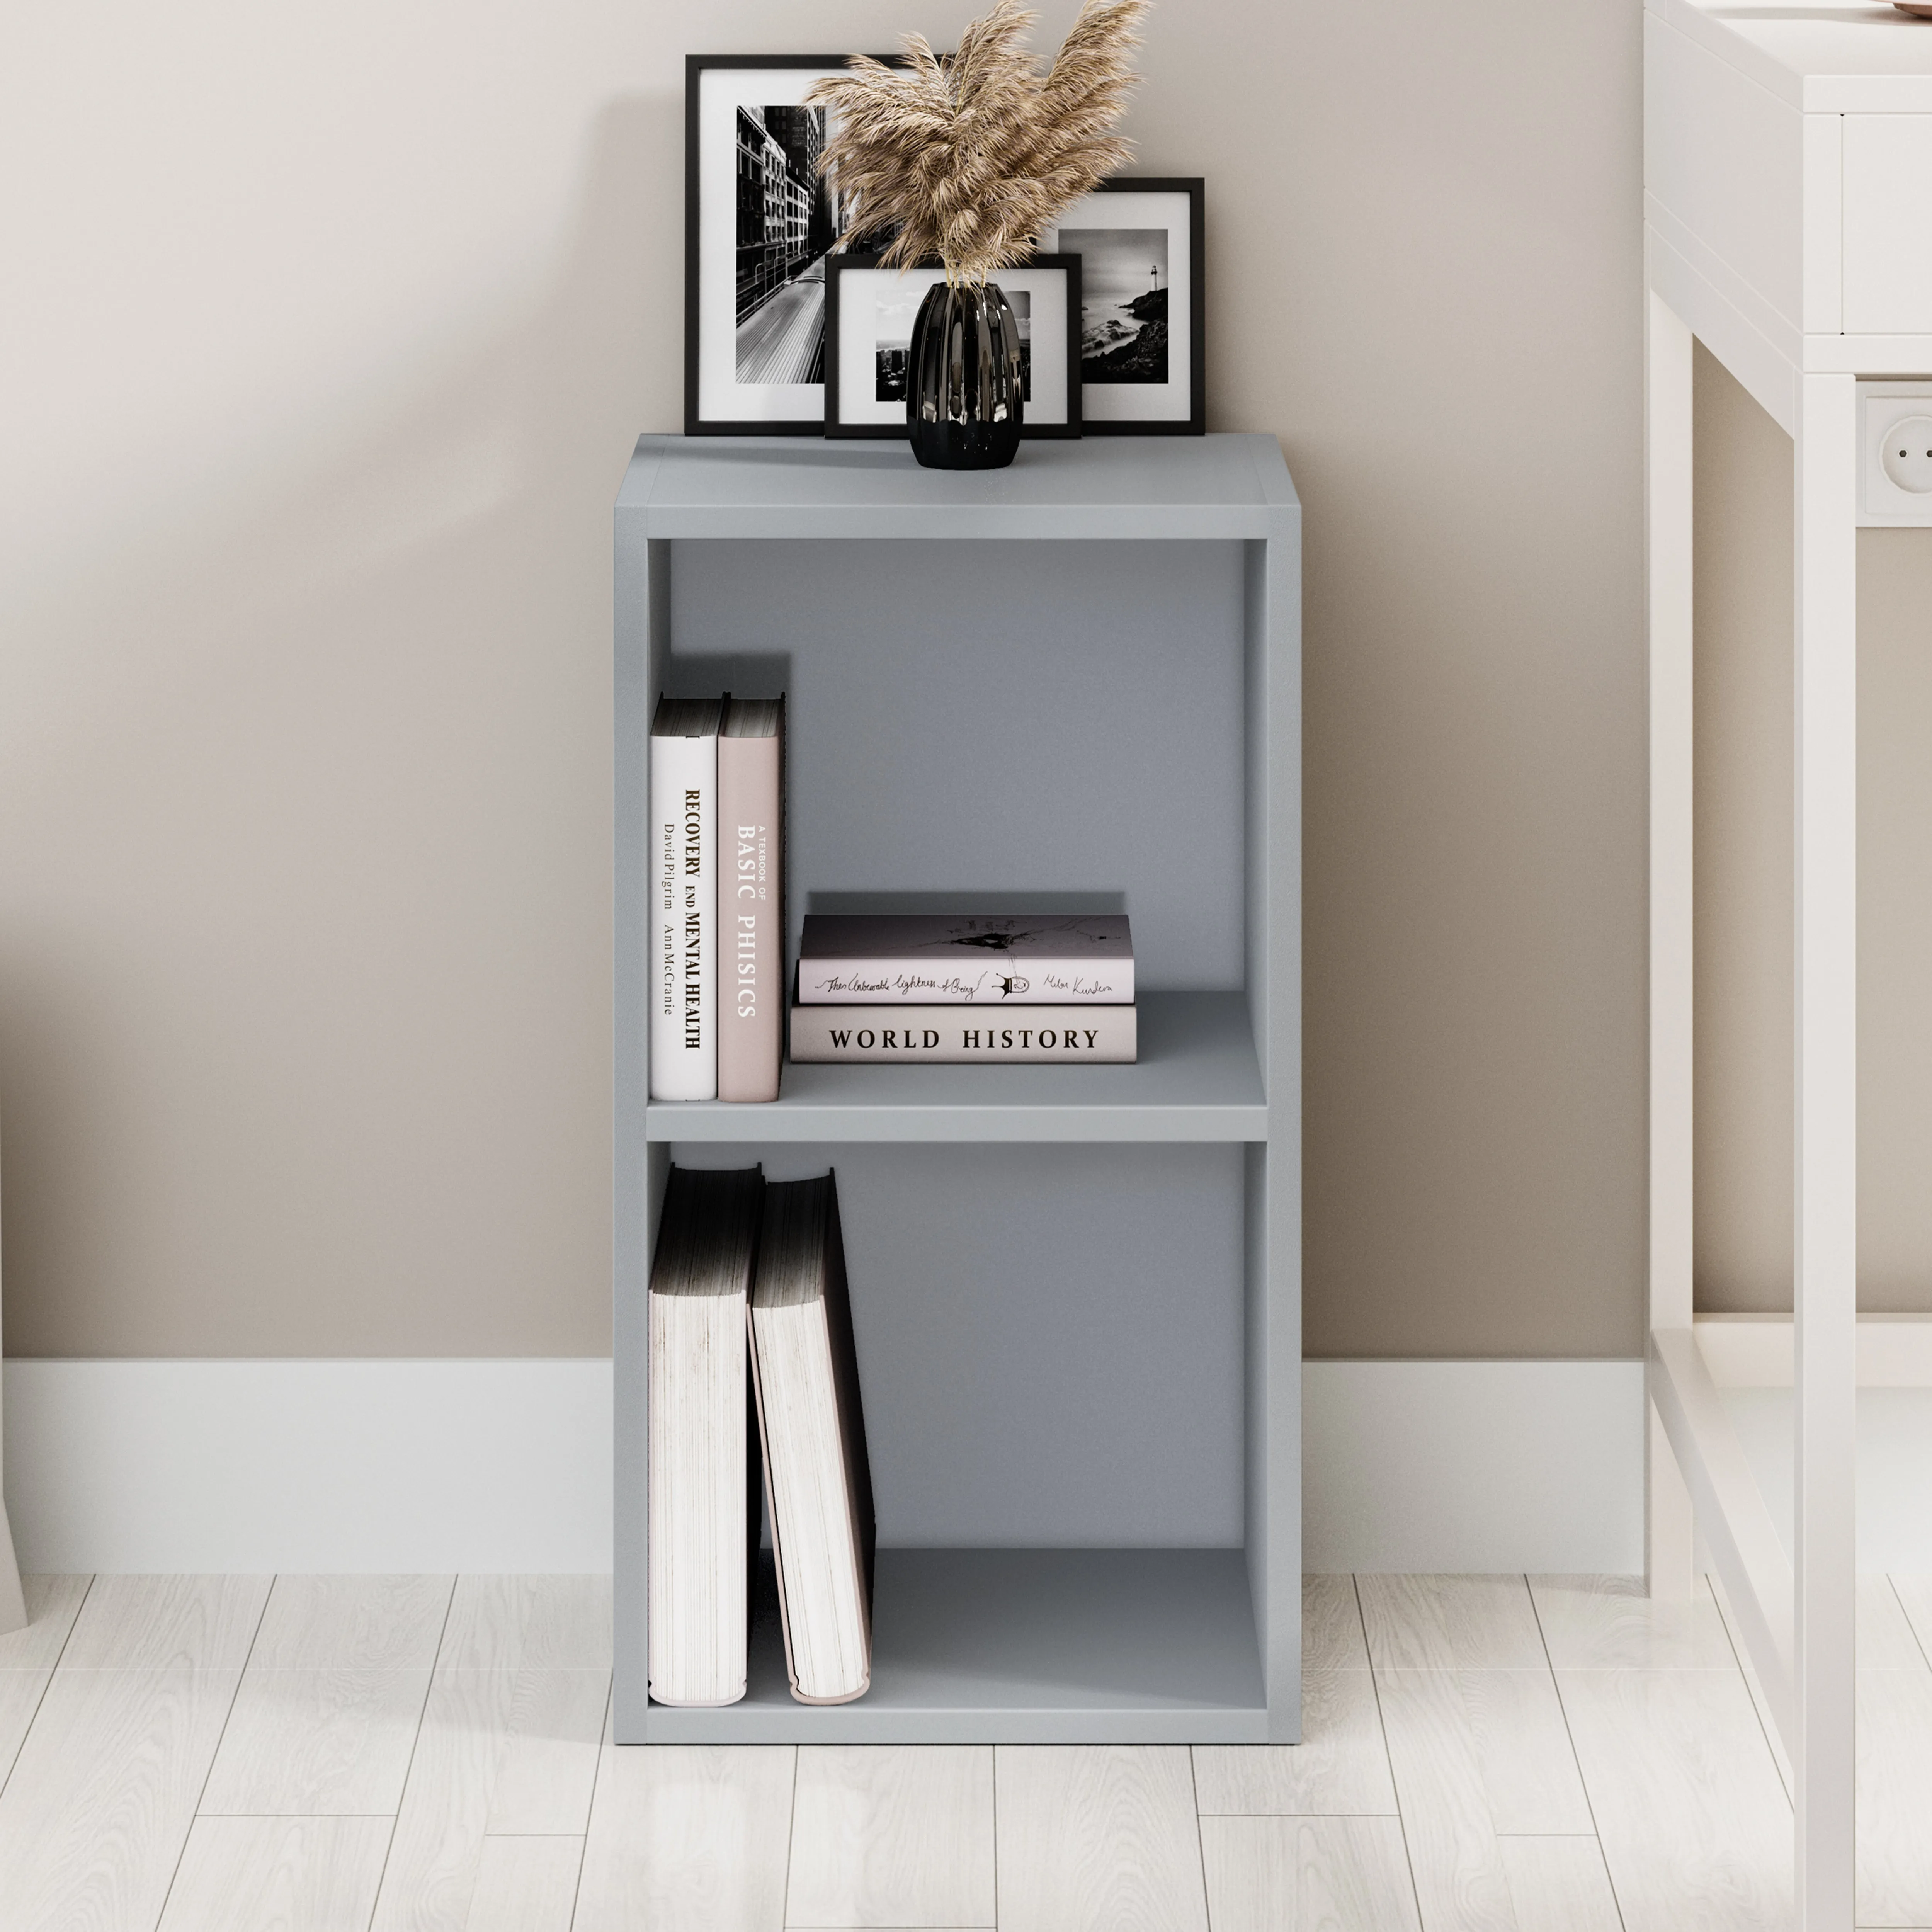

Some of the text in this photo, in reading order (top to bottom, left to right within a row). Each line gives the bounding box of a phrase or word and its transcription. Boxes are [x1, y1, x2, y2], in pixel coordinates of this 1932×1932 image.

[662, 824, 675, 1015] David Pilgrim Ann McCranie
[685, 790, 700, 1049] RECOVERY END MENTAL HEALTH
[738, 825, 756, 1018] BASIC PHISICS
[759, 887, 766, 900] OF
[829, 1029, 1099, 1049] WORLD HISTORY
